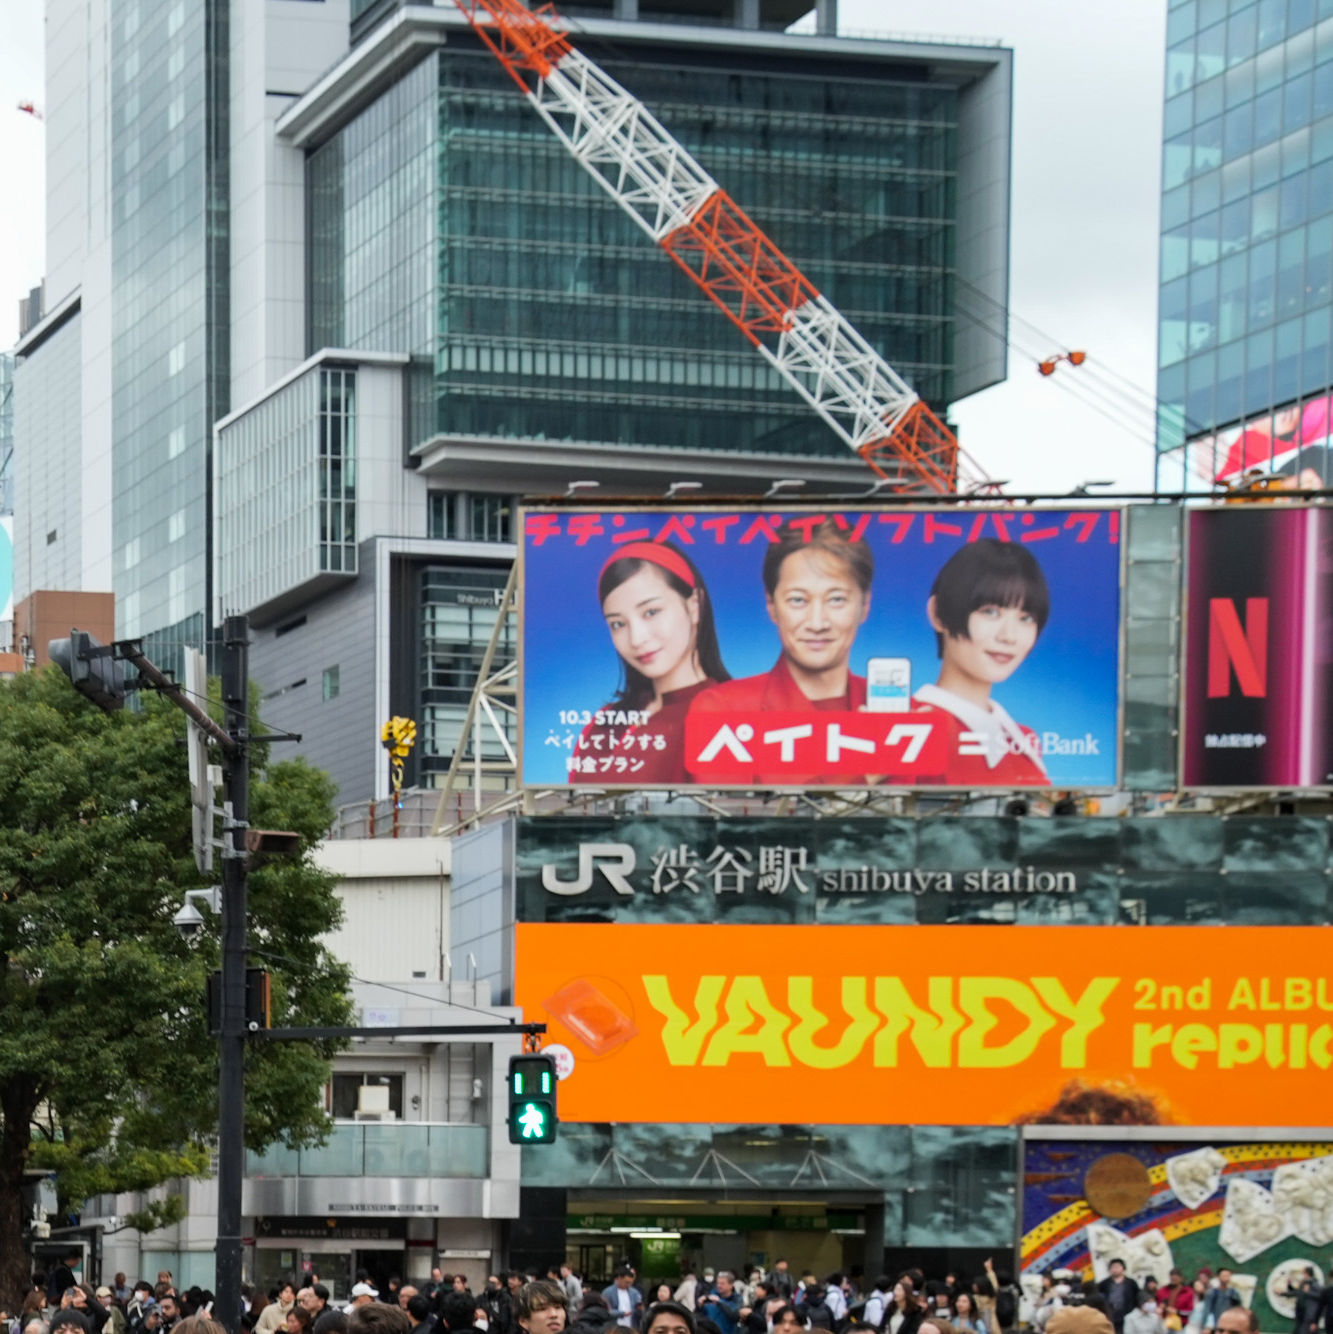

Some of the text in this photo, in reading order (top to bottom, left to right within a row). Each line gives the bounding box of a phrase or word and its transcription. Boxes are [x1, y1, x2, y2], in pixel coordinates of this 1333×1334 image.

[526, 511, 1119, 546] チチンペイペイソフトバンク!
[559, 711, 651, 726] 10.3 START
[697, 723, 933, 763] ペイトク
[996, 731, 1100, 756] SoftBank
[566, 756, 645, 774] 料金プラン
[541, 842, 1077, 903] JR 渋谷駅 shibuya station
[1133, 976, 1212, 1011] 2nd
[640, 974, 1121, 1069] VAUNDY
